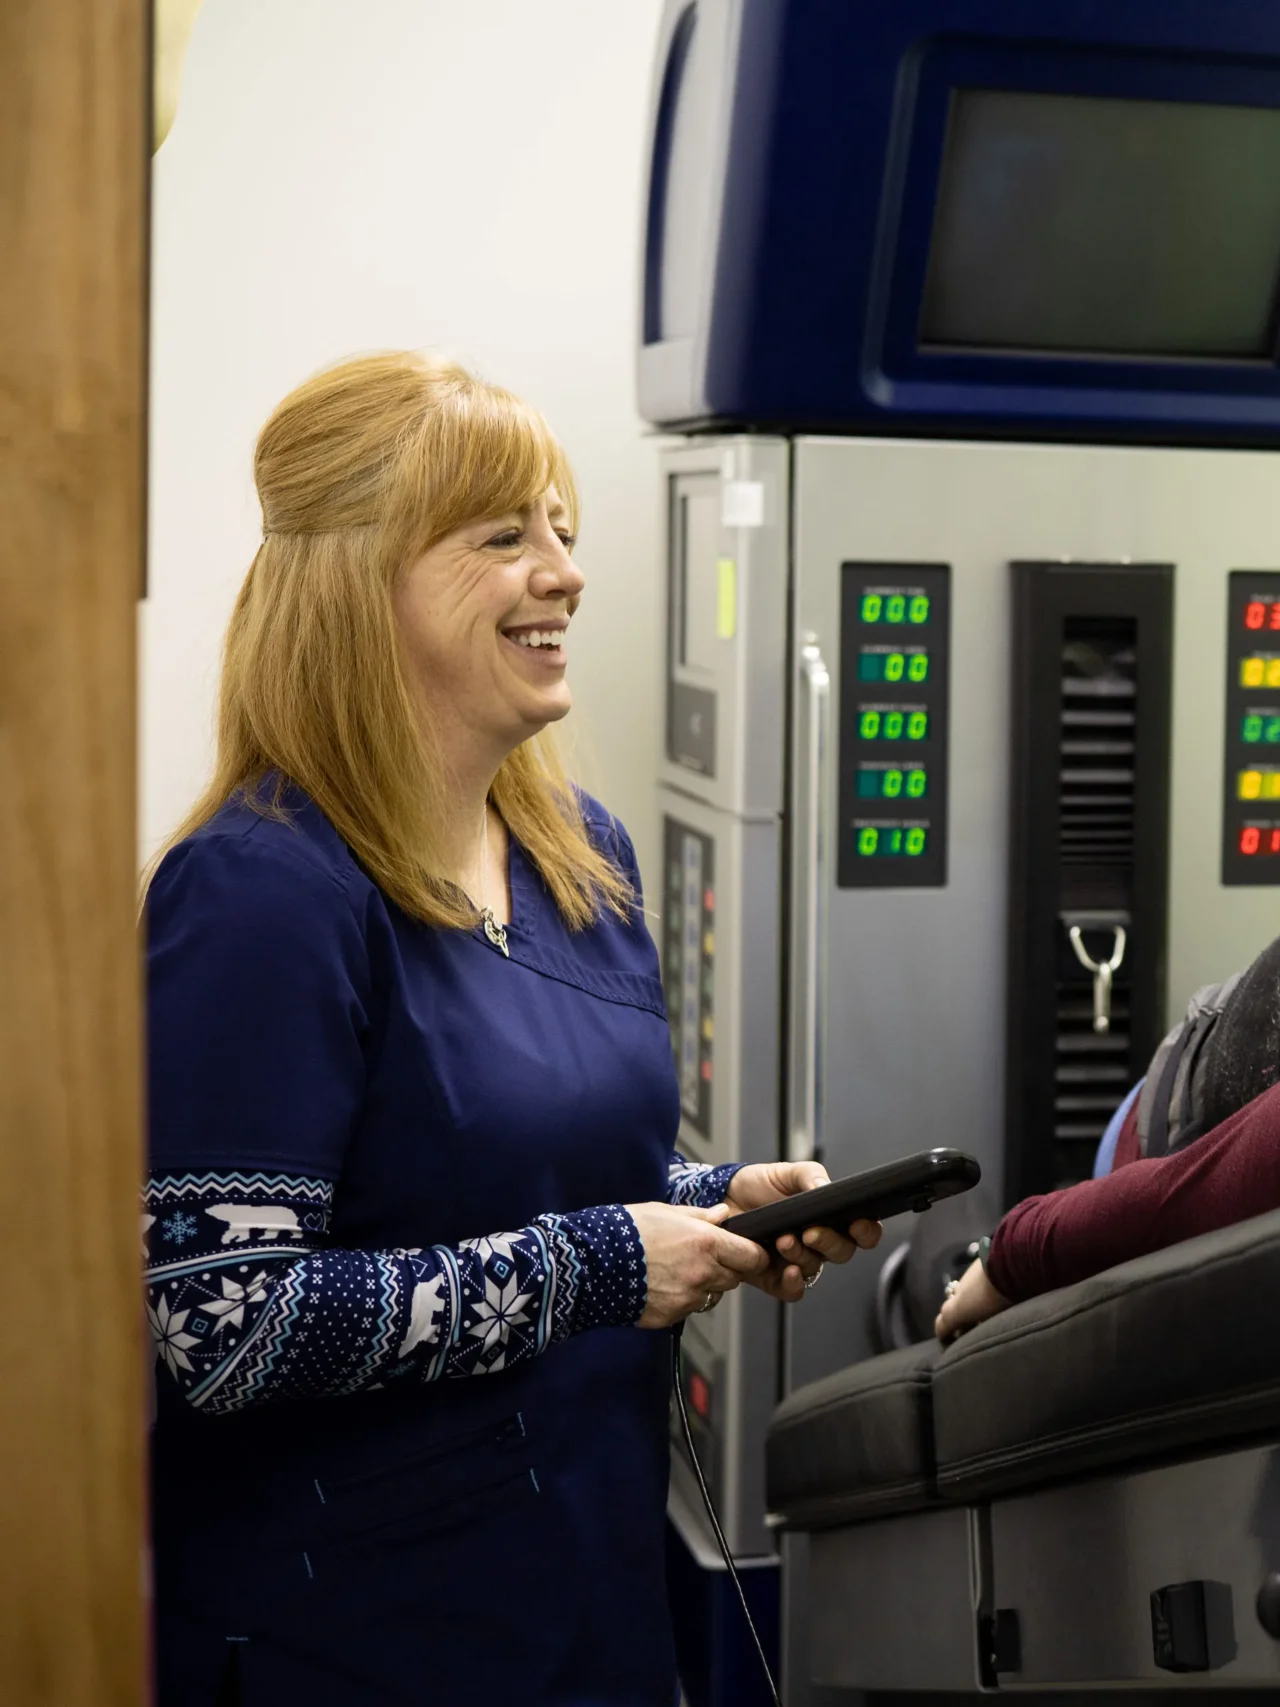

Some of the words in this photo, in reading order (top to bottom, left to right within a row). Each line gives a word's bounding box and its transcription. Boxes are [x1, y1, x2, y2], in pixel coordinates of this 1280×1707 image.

[884, 653, 929, 682] 00
[861, 711, 928, 739] 000
[882, 768, 927, 798] 00
[859, 827, 926, 855] 010
